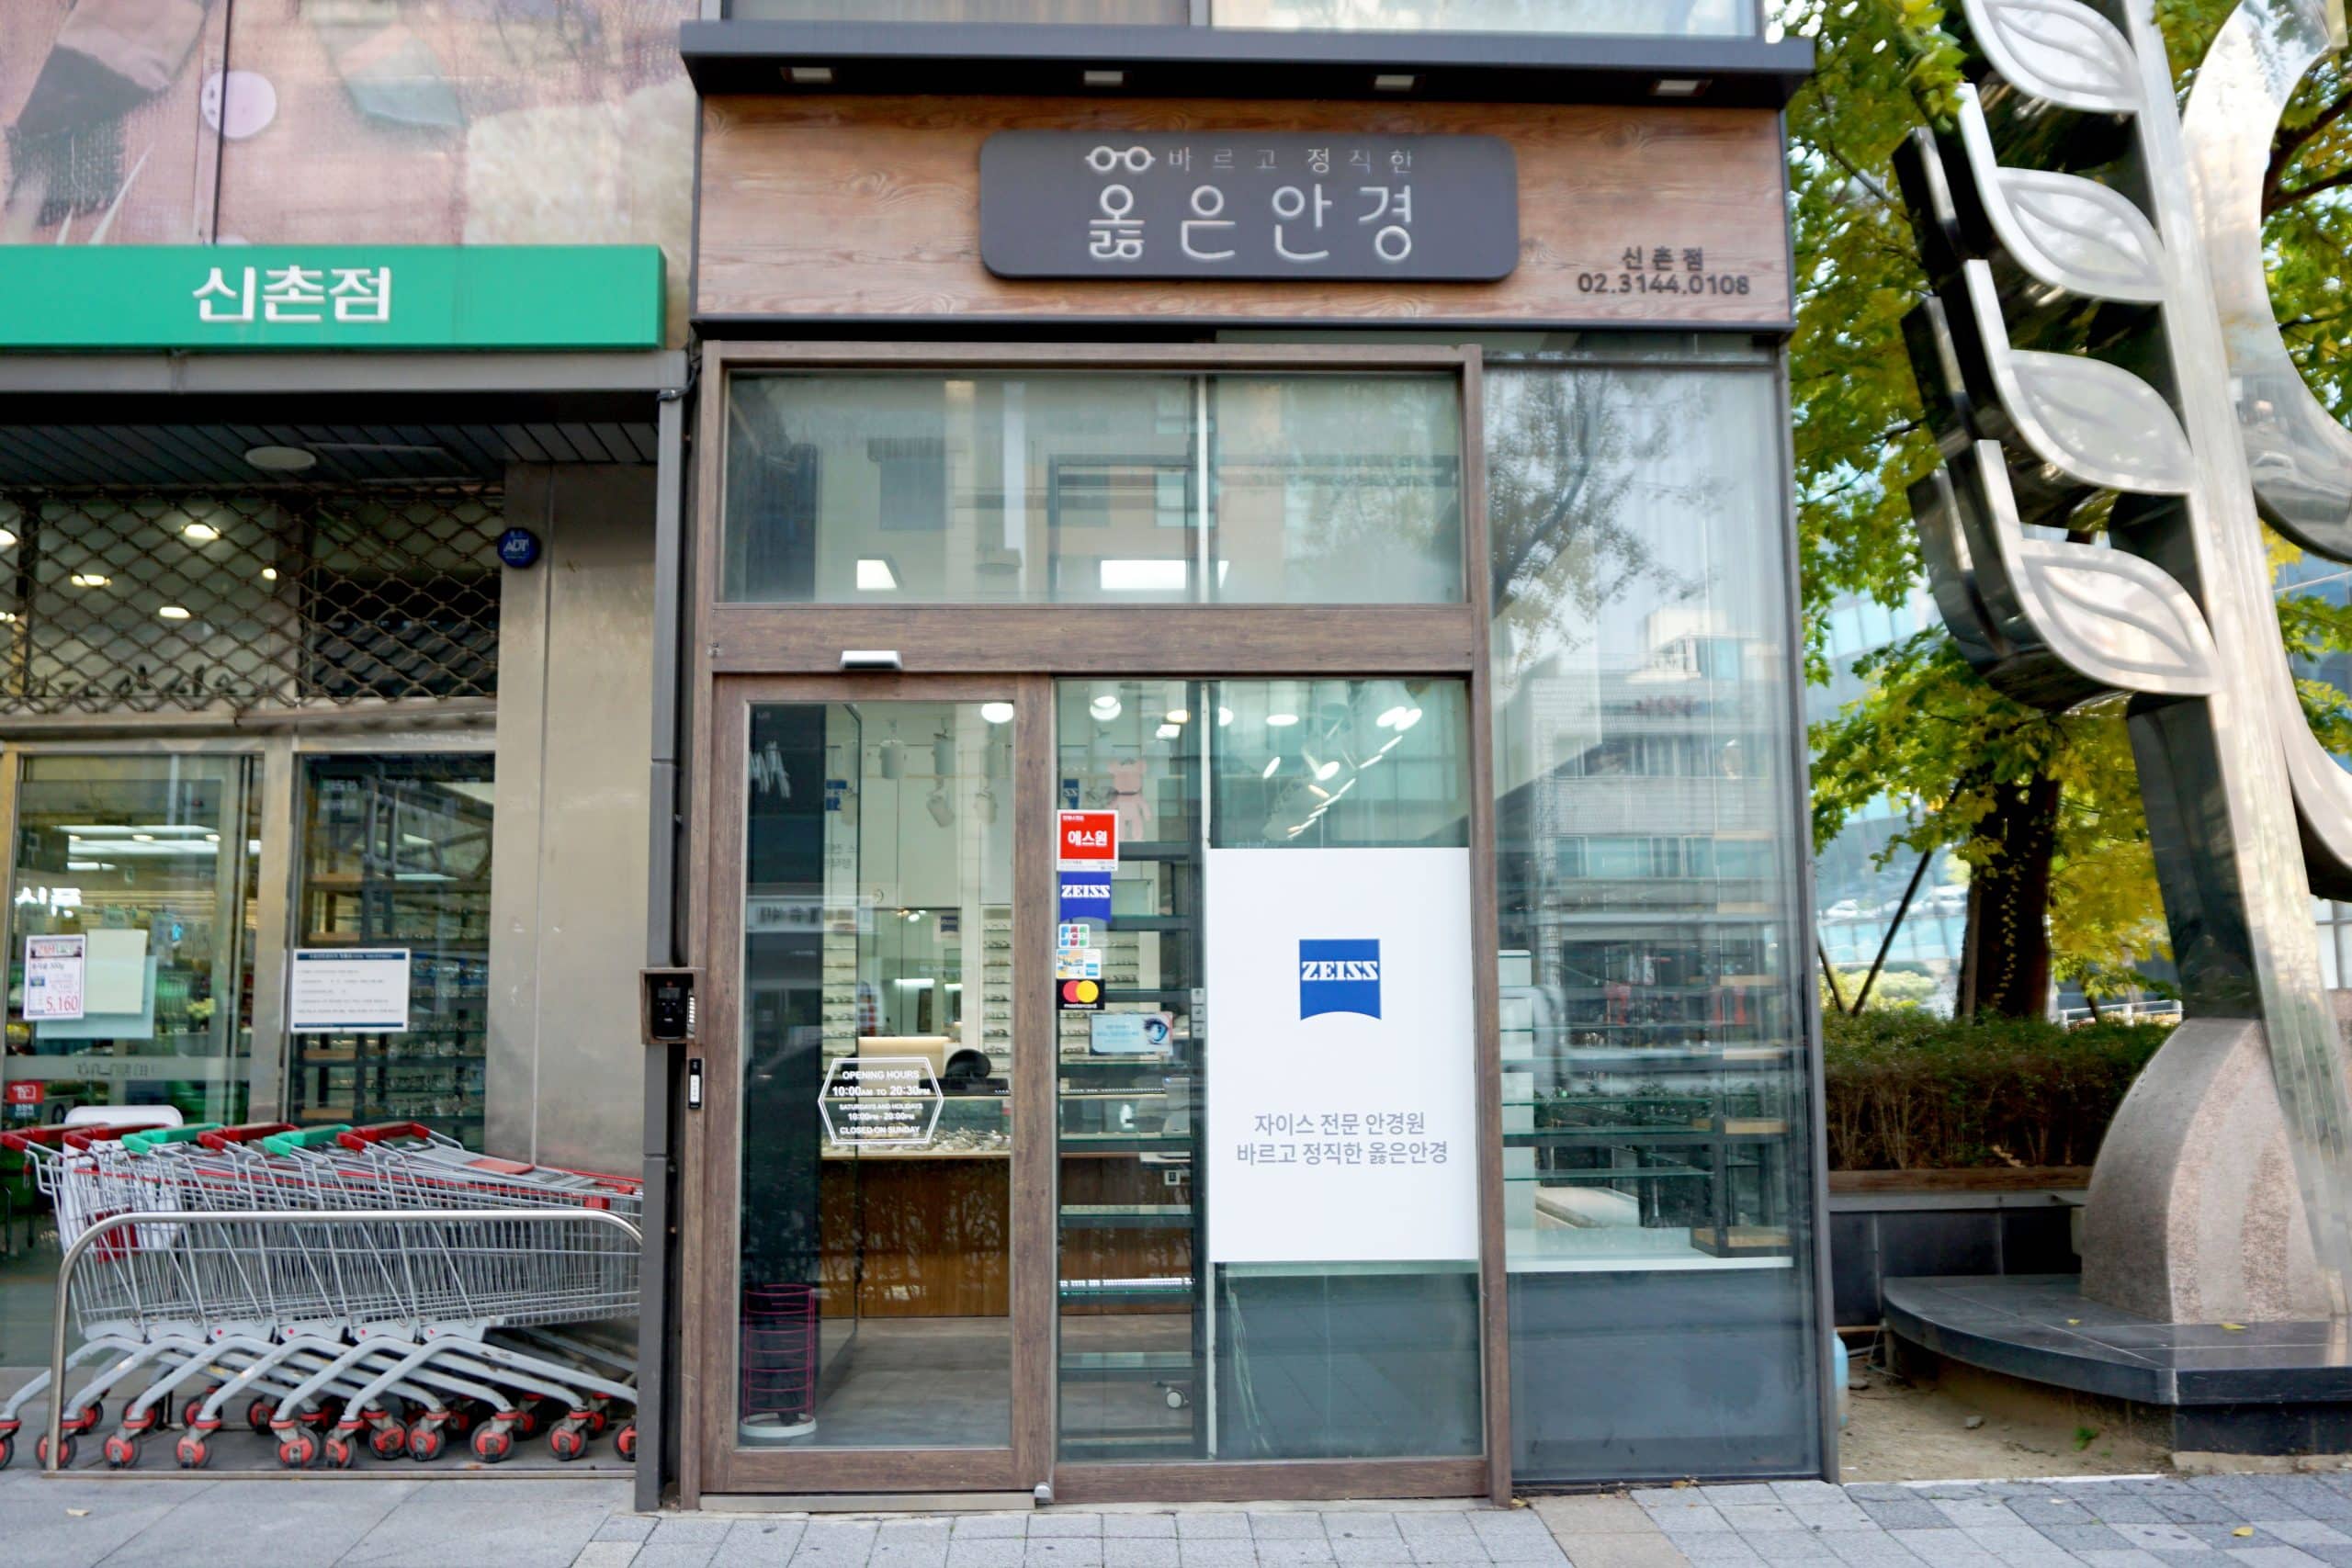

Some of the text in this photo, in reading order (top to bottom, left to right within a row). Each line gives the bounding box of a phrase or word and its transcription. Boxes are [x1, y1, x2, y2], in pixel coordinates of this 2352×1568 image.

[1168, 146, 1413, 175] 바르고 정직한
[1088, 183, 1413, 262] 옳은안경
[1622, 245, 1705, 272] 신촌점
[192, 265, 391, 323] 신촌점
[1577, 273, 1751, 296] 02.3144.0108
[503, 538, 530, 553] ADT
[1067, 829, 1109, 847] 에스원
[1061, 885, 1111, 899] ZEISS
[1063, 931, 1088, 941] JCB
[1301, 960, 1379, 982] ZEISS
[842, 1070, 920, 1080] OPENING HOURS
[831, 1086, 873, 1097] 10:00AM
[839, 1126, 872, 1134] CLOSED
[888, 1125, 921, 1134] SUNDAY
[1254, 1111, 1425, 1136] 자이스 전문 안경원
[1237, 1140, 1448, 1166] 바르고 정직한 옳은안경
